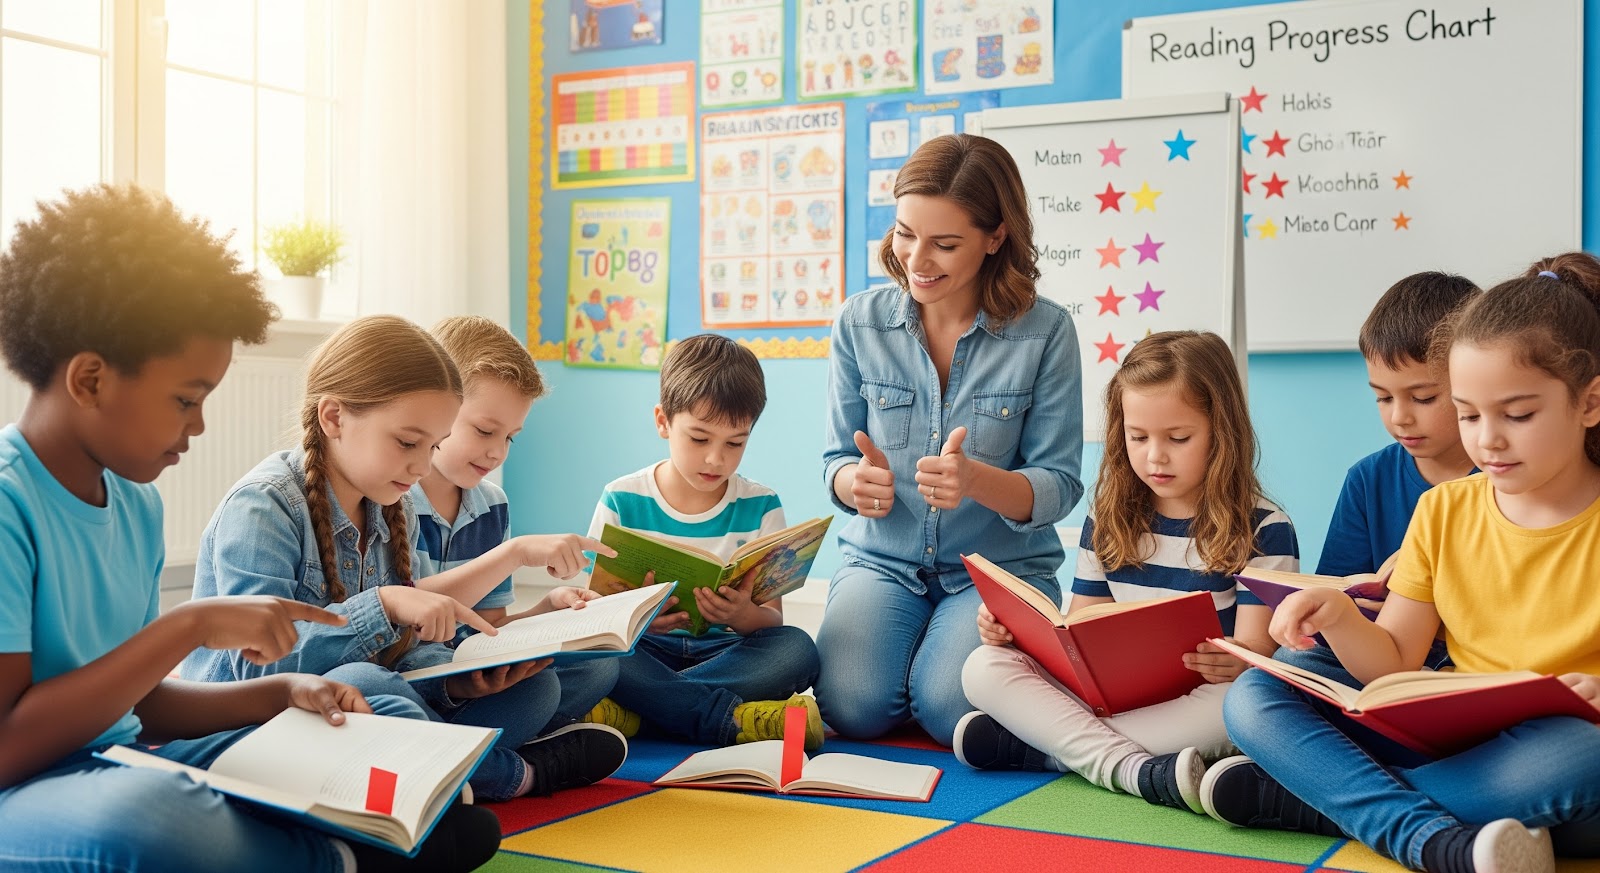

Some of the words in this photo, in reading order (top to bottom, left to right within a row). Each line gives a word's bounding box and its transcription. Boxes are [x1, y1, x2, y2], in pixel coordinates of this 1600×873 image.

[1149, 27, 1255, 68] Reading
[1268, 20, 1389, 62] Progress
[1405, 7, 1496, 41] Chart
